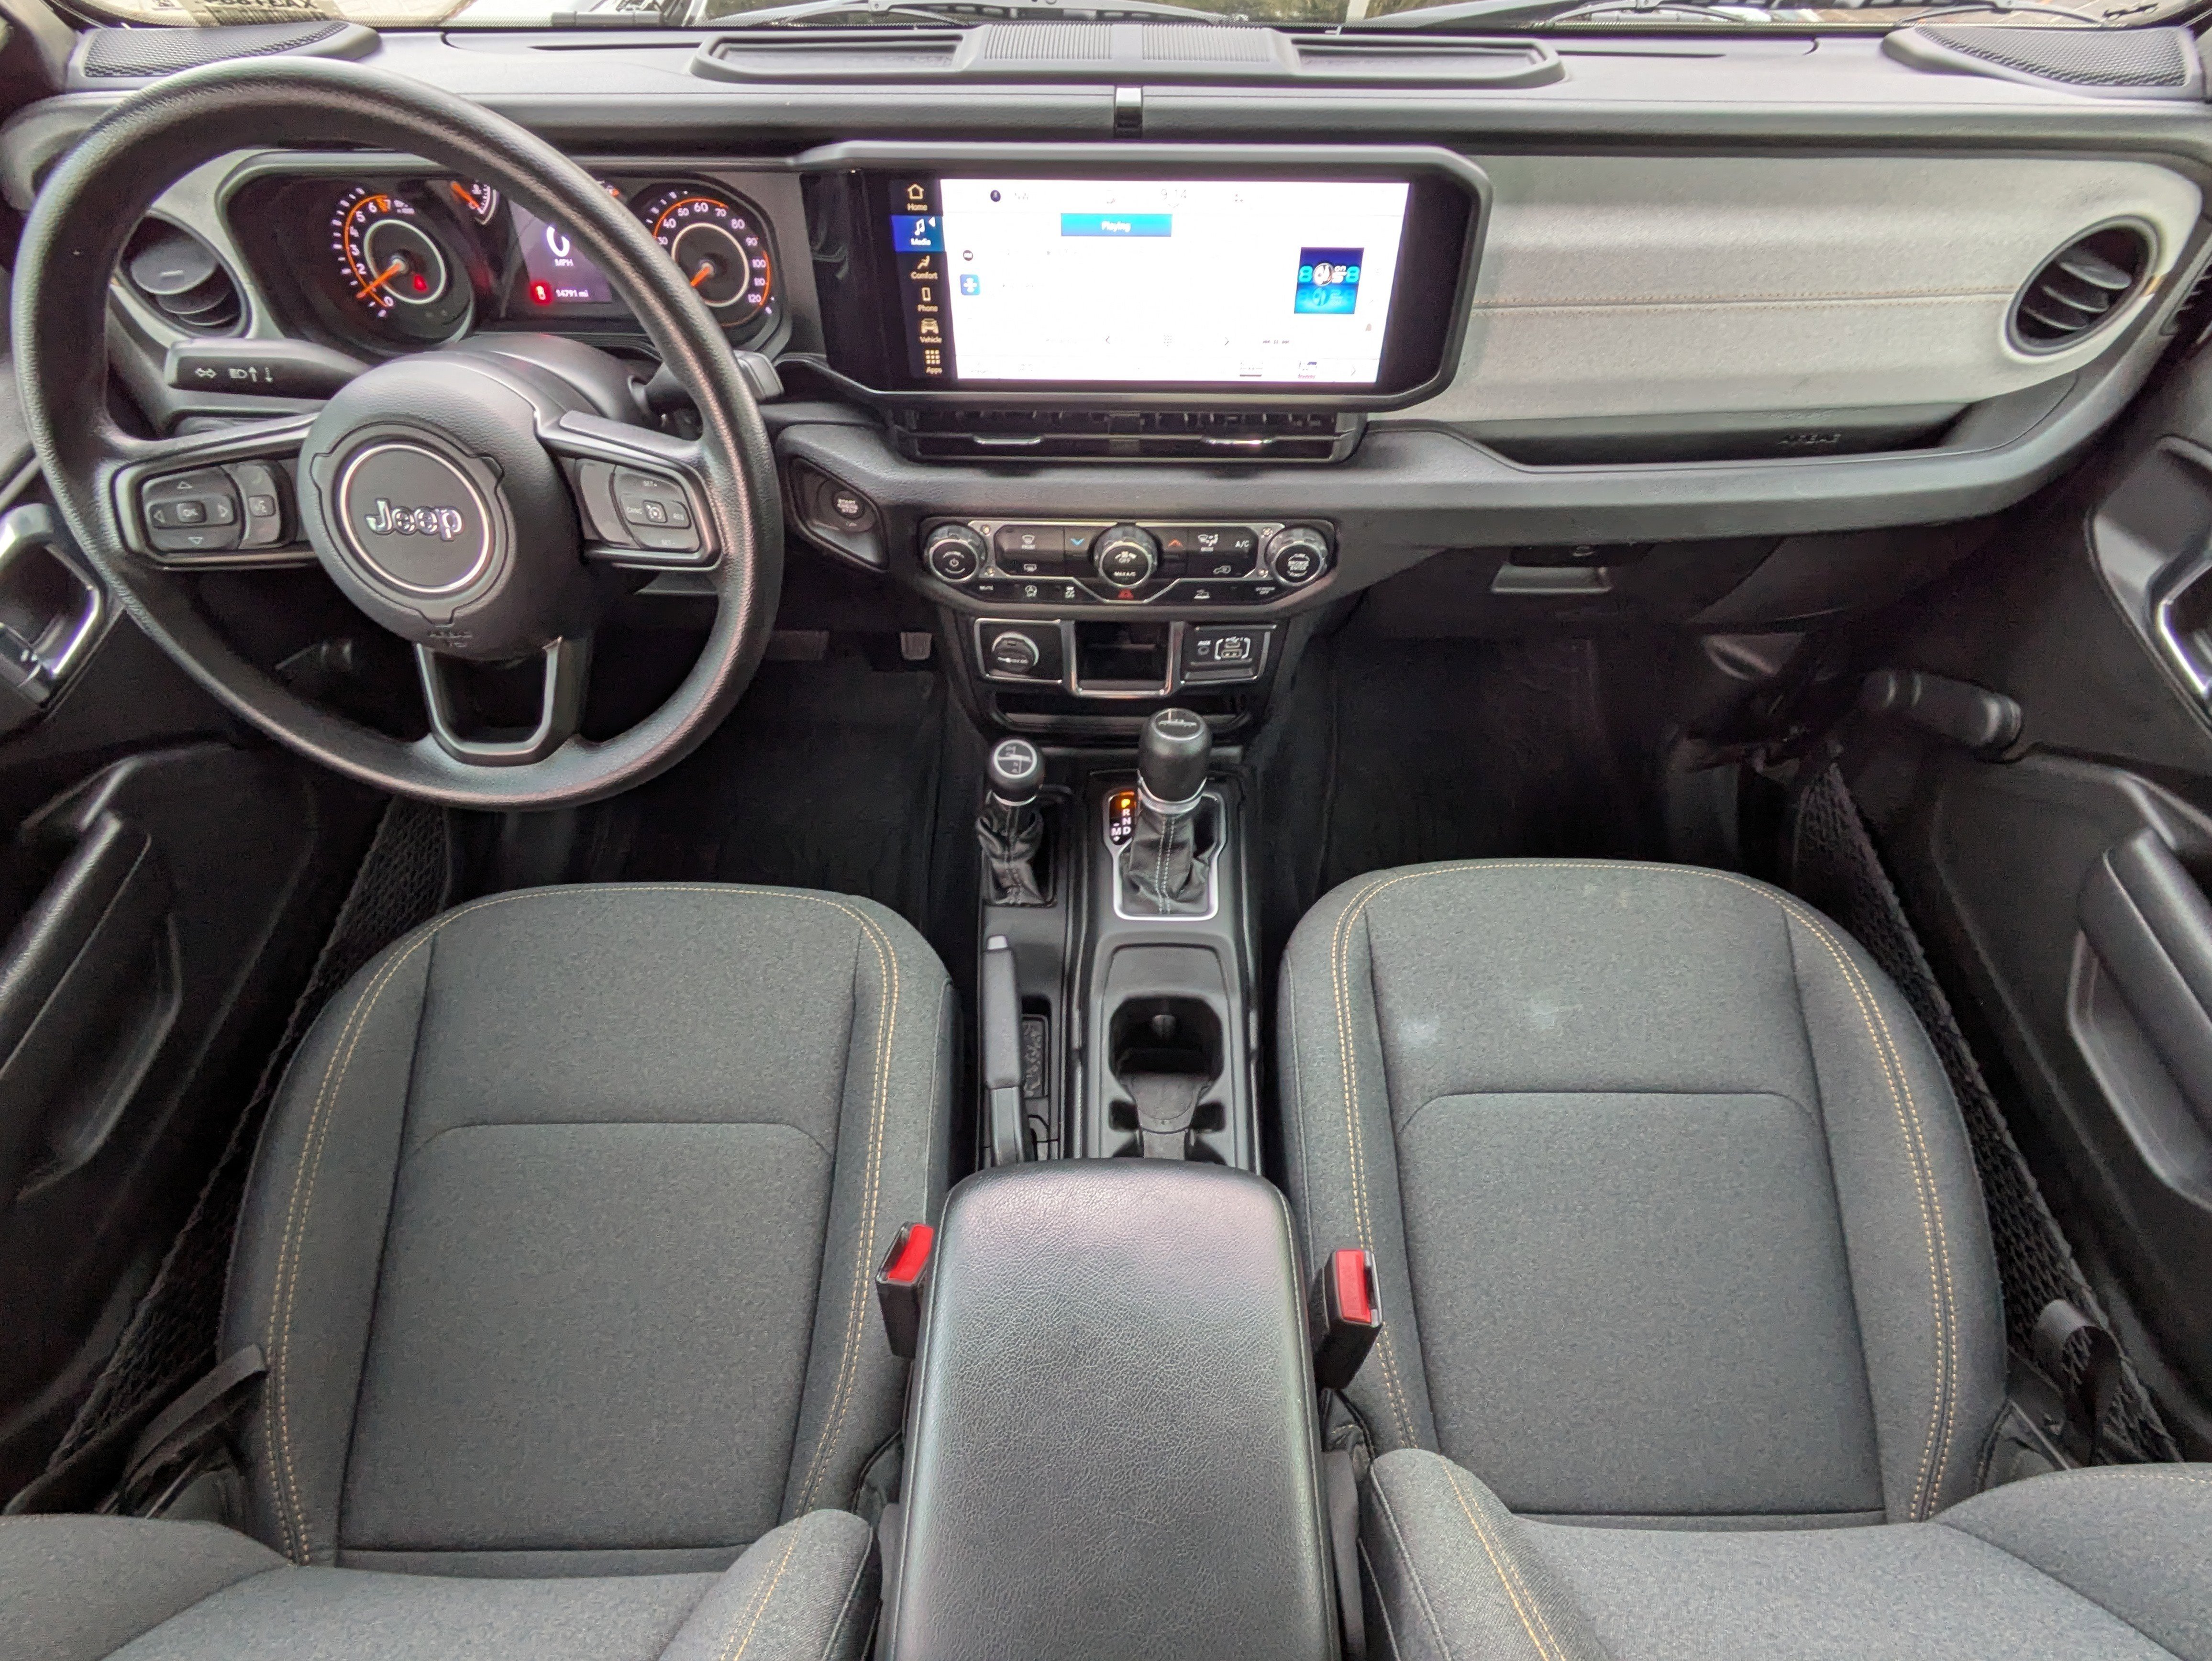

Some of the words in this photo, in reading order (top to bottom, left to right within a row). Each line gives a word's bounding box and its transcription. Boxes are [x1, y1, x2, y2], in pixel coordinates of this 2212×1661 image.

[368, 202, 377, 213] 6
[694, 202, 709, 213] 60
[907, 203, 928, 211] Home
[677, 207, 689, 217] 50
[715, 208, 727, 218] 70
[663, 218, 676, 228] 40
[731, 218, 745, 229] 80
[1101, 221, 1131, 233] Playing
[745, 237, 758, 246] 90
[350, 244, 360, 256] 3
[554, 258, 574, 266] MPH
[752, 259, 766, 268] 100
[356, 263, 367, 275] 2
[910, 271, 938, 280] Comfort
[383, 296, 394, 307] 0
[748, 294, 762, 303] 120
[918, 304, 938, 312] Phone
[182, 508, 198, 517] OK
[364, 498, 464, 542] Jeep
[1121, 798, 1131, 808] P
[1122, 808, 1130, 817] R
[1122, 817, 1131, 826] N
[1111, 827, 1122, 836] M
[1122, 826, 1131, 835] D
